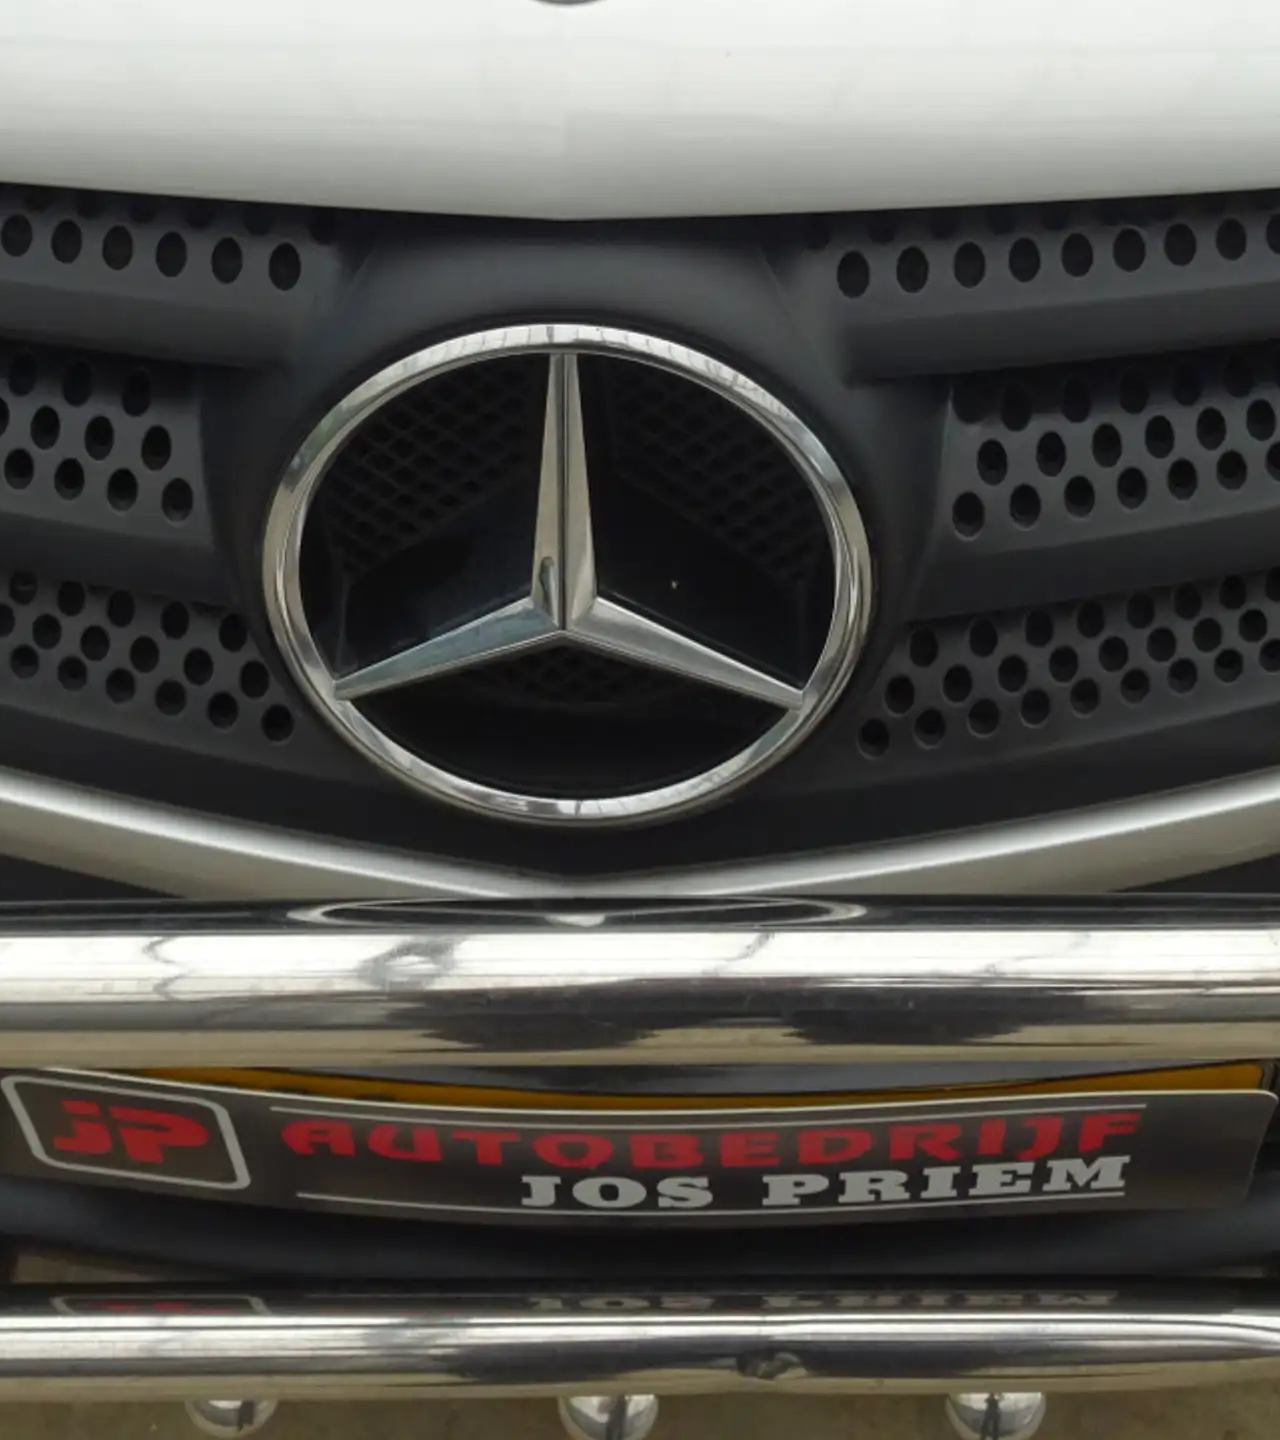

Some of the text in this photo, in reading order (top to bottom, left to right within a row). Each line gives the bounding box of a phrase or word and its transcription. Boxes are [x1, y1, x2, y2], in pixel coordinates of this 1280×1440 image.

[282, 1111, 1141, 1169] AUTOBEDRIJF
[520, 1155, 1131, 1208] JOS PRIEM
